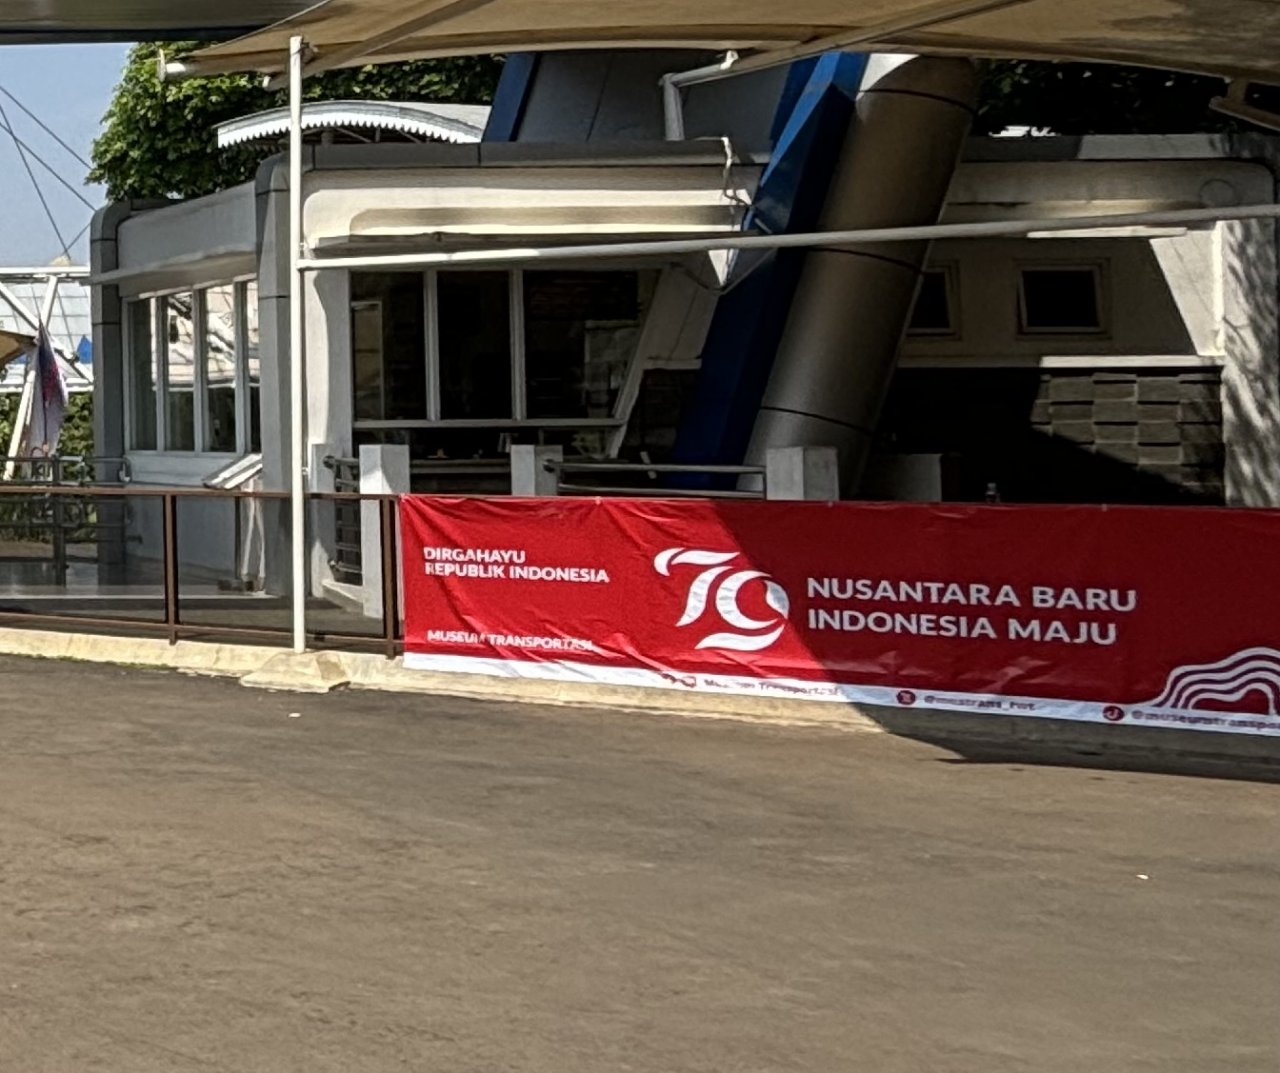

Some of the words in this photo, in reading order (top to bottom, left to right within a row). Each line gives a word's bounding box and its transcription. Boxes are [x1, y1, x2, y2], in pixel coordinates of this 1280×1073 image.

[424, 547, 526, 563] DIRGAHAYU
[425, 562, 504, 579] REPUBLIK
[509, 566, 609, 584] INDONESIA
[807, 577, 1020, 608] NUSANTARA
[1031, 585, 1137, 612] BARU
[808, 608, 997, 640] INDONESIA
[1007, 618, 1117, 646] MAJU
[487, 633, 593, 651] TRANSPORTASI
